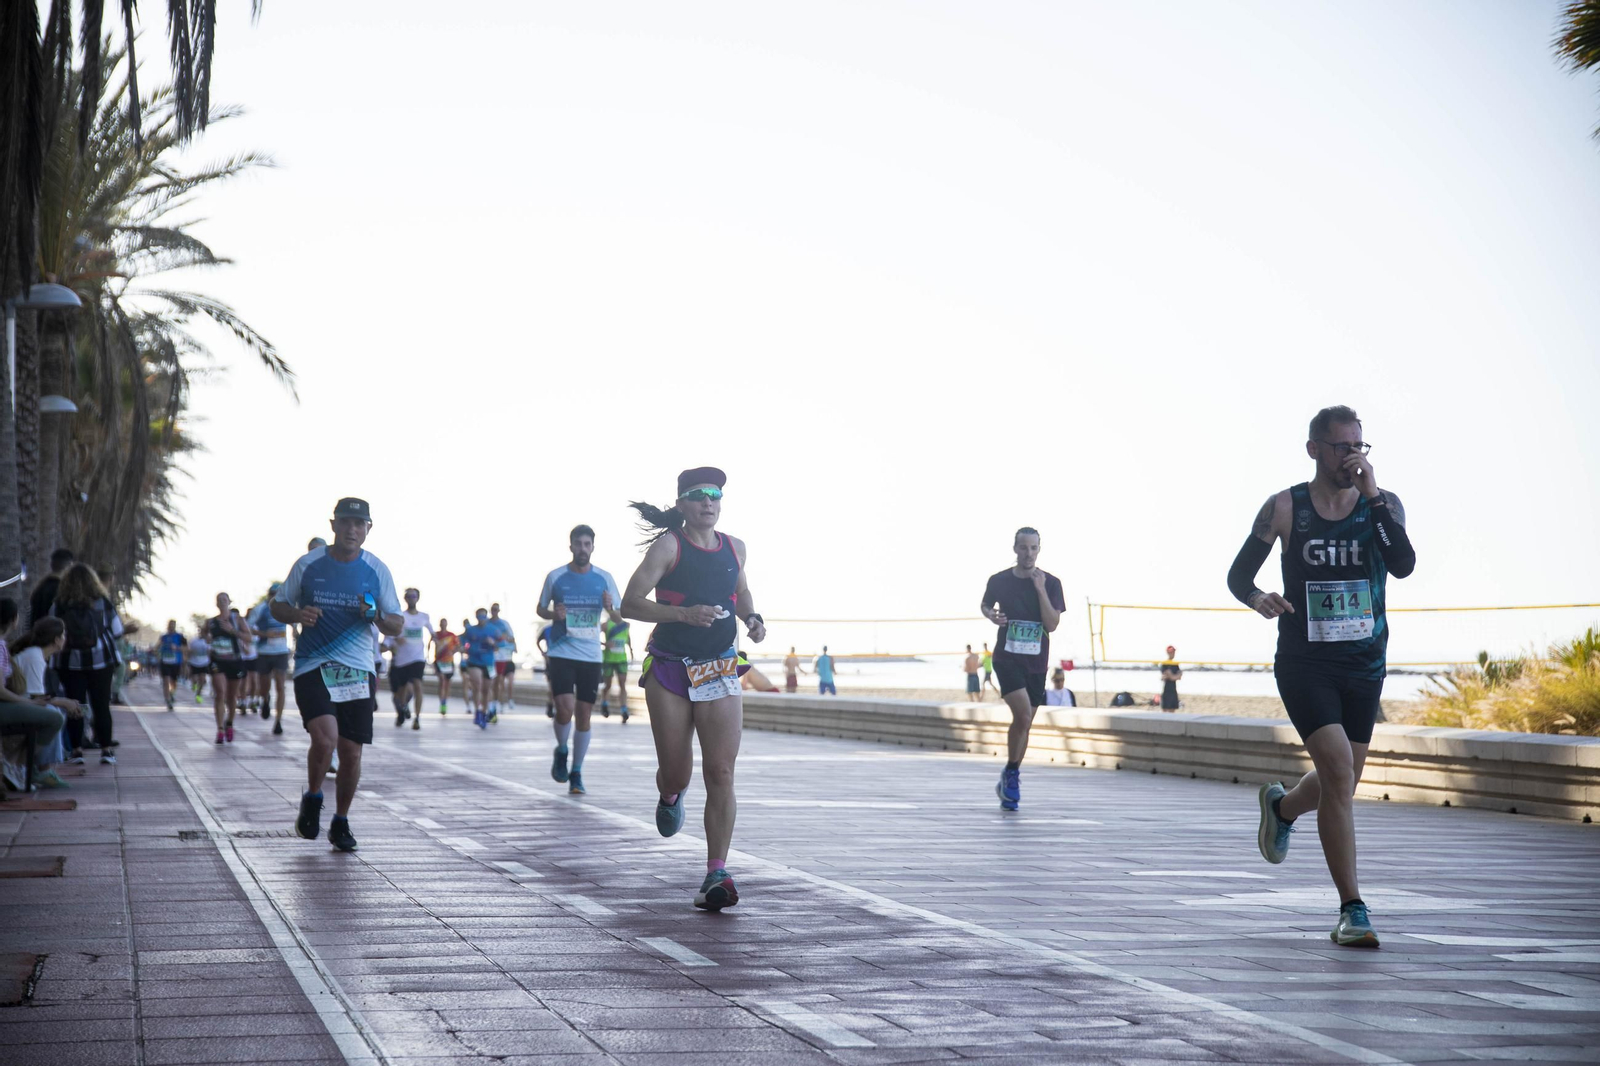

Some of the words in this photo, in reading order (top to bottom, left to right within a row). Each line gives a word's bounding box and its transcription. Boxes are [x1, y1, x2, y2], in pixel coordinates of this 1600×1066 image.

[1376, 522, 1391, 547] KIPRUN
[1302, 539, 1364, 566] Giit
[313, 590, 337, 598] Medio
[338, 592, 359, 600] Mara
[1321, 592, 1360, 611] 414
[574, 613, 593, 624] 740
[1012, 625, 1040, 638] 1179
[690, 658, 734, 682] 2207
